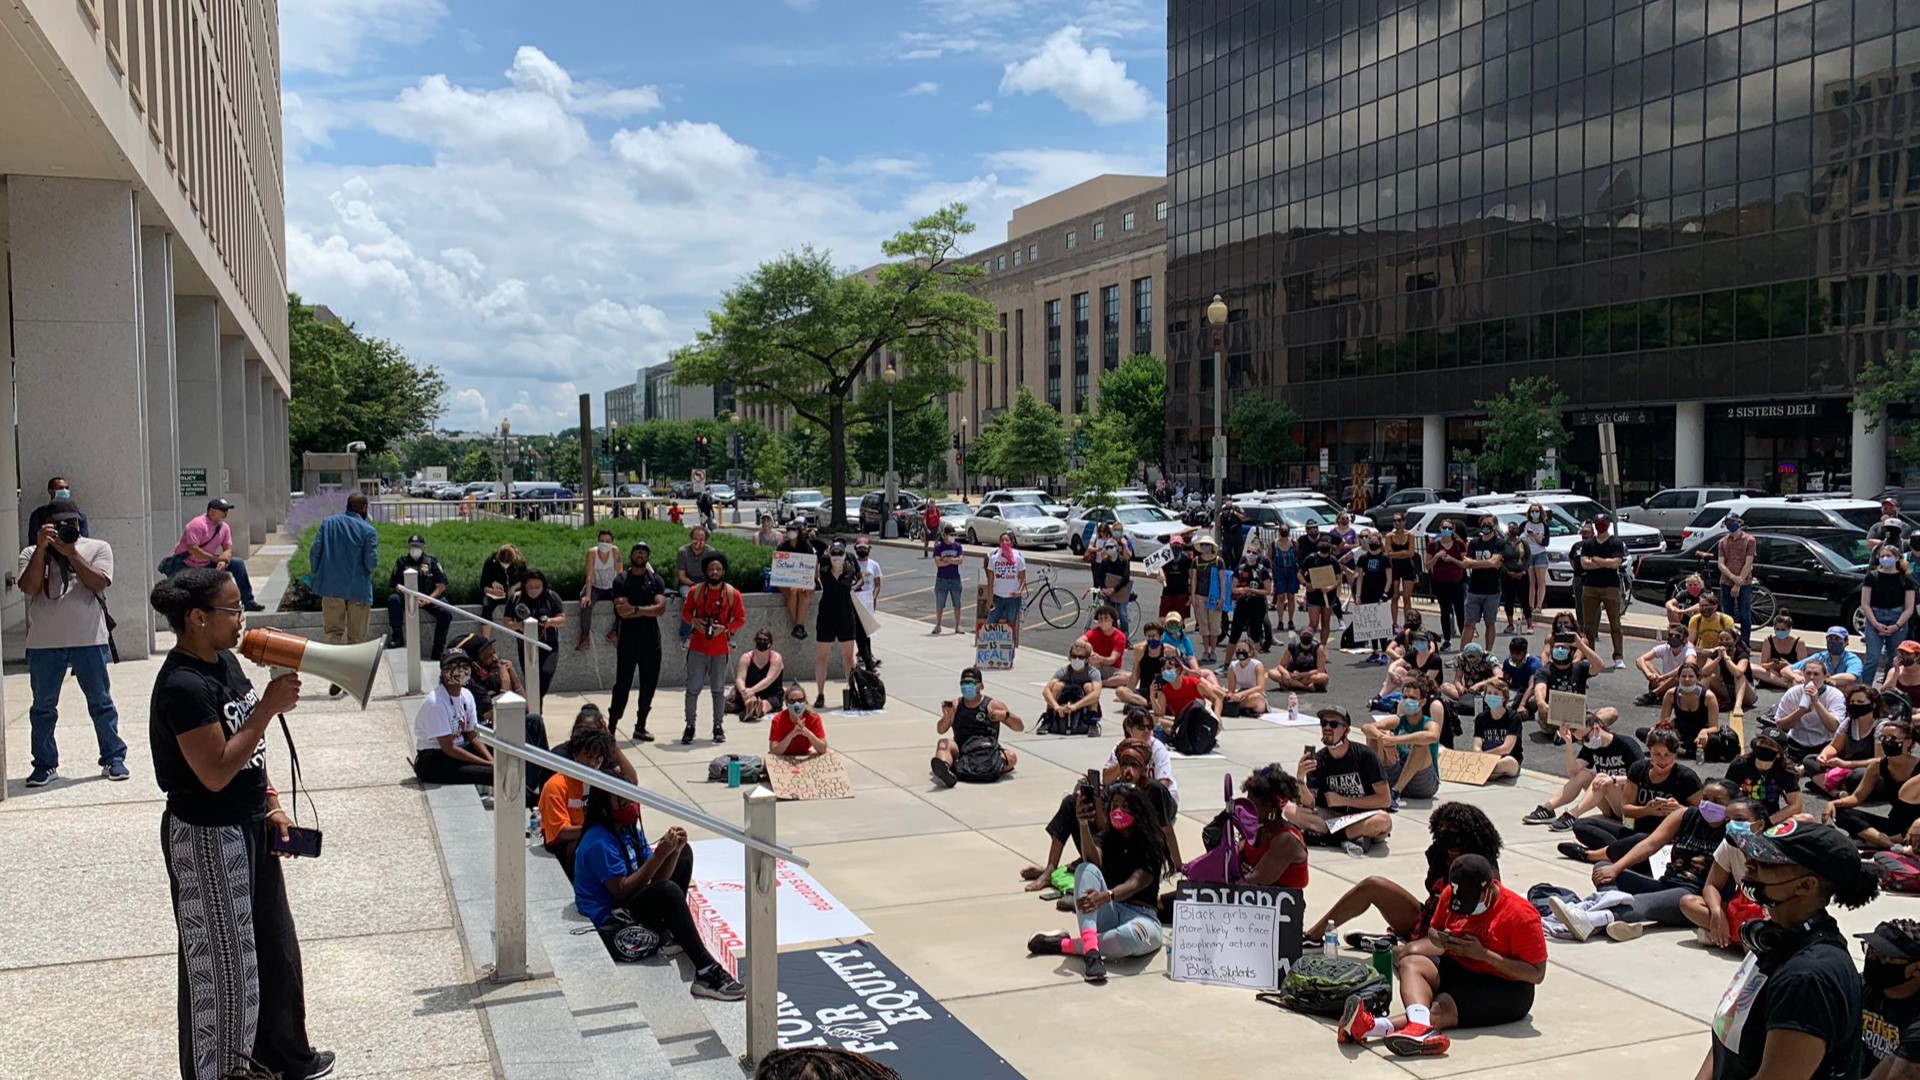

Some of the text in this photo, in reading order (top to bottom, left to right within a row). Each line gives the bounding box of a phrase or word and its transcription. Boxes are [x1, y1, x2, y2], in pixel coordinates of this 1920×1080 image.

[1594, 412, 1612, 423] Sal's
[1727, 403, 1816, 418] 2 SISTERS DELI
[1144, 552, 1160, 568] BLM
[984, 623, 1008, 632] UNTIL
[981, 632, 1012, 642] JUSTICE
[989, 641, 997, 650] IS
[1593, 754, 1626, 767] BLACK
[1329, 774, 1358, 788] BLACK
[1179, 906, 1271, 924] Black girls are
[1178, 923, 1269, 939] more likely to face
[1229, 940, 1255, 949] action
[1260, 941, 1268, 949] in
[1186, 963, 1219, 978] Black
[816, 949, 932, 1026] EQUITY
